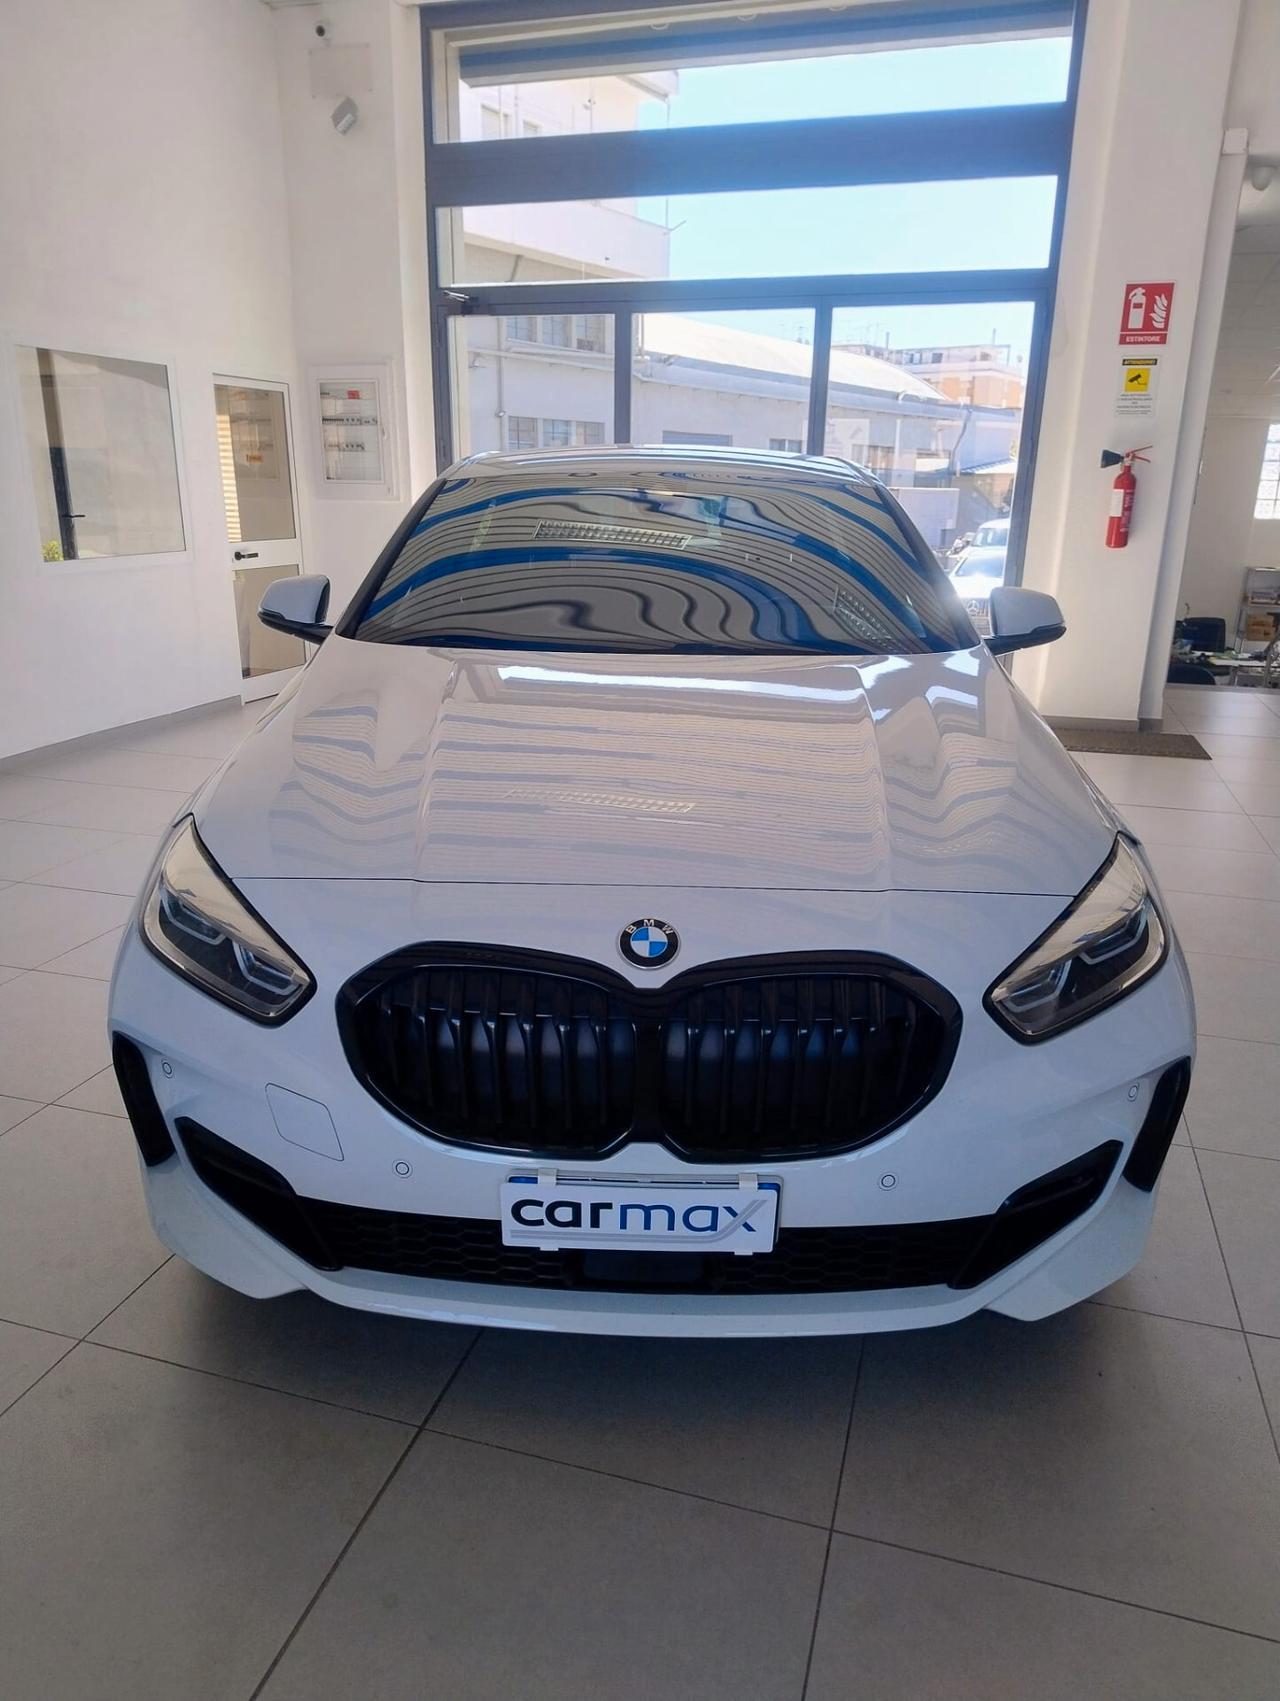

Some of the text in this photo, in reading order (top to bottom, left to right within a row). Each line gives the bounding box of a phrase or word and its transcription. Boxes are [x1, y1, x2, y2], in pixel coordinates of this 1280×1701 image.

[1125, 335, 1161, 343] ESTINTORE
[625, 919, 674, 934] BMW
[510, 1198, 764, 1234] carmax
